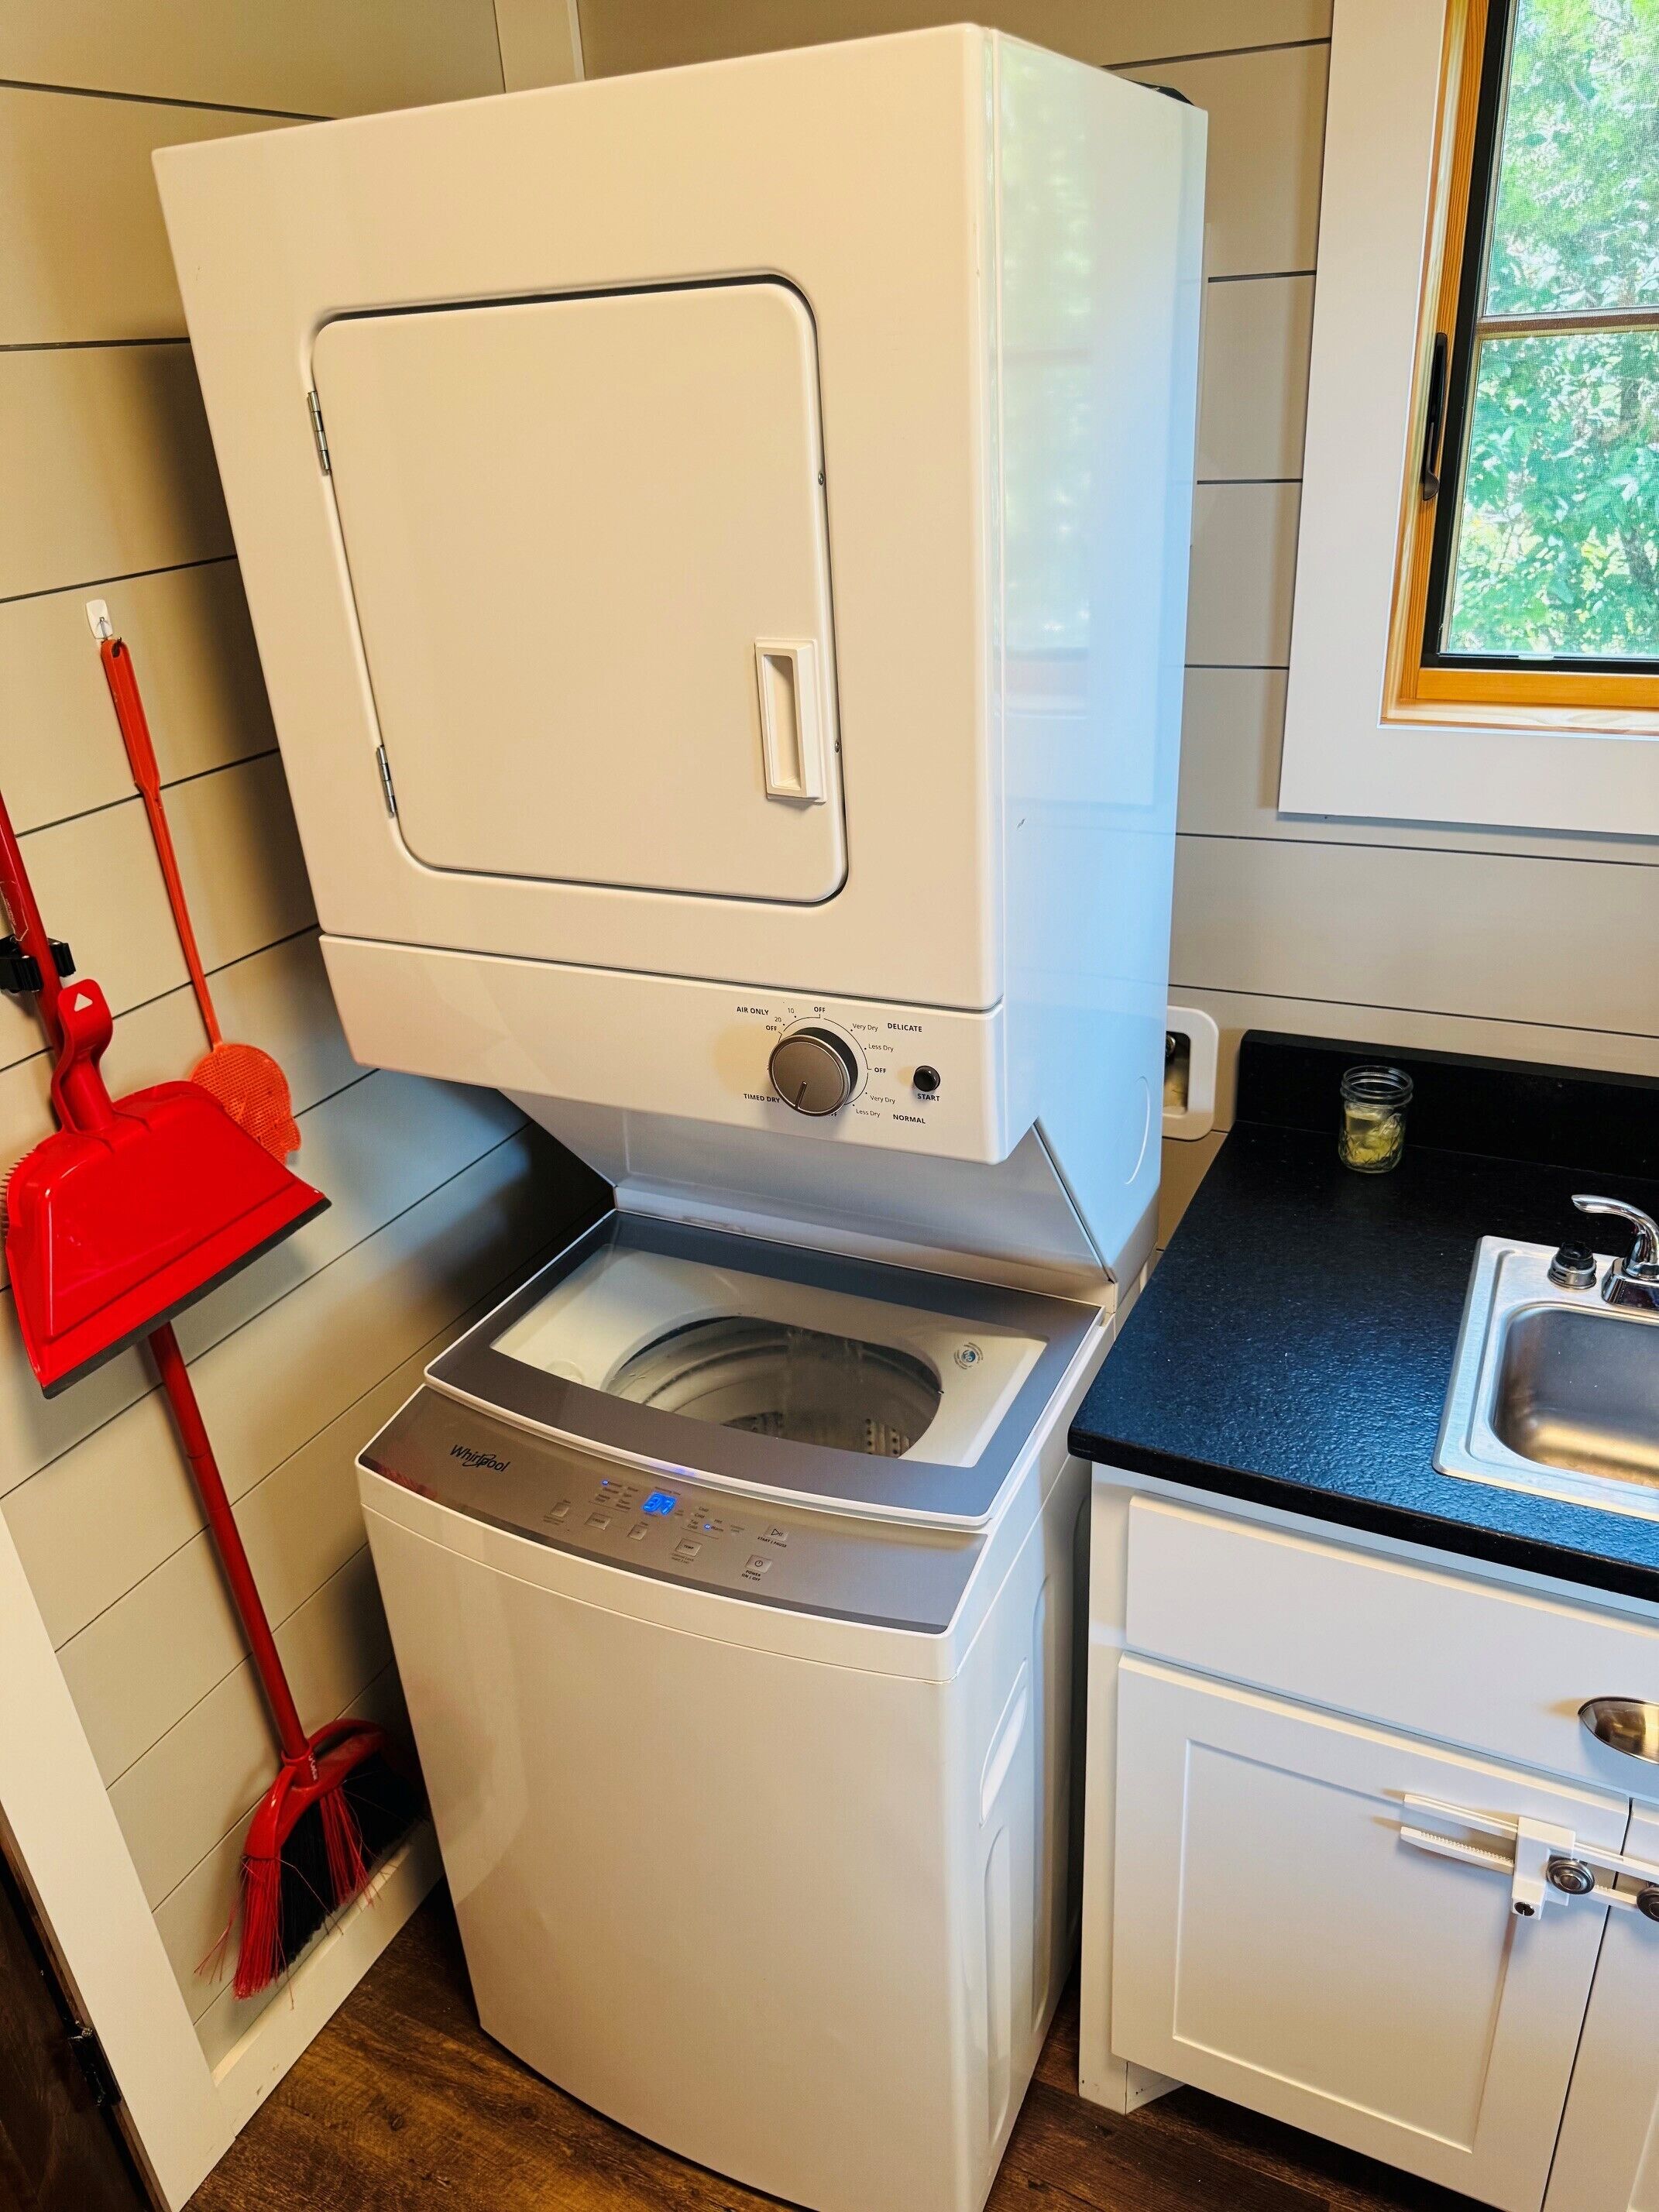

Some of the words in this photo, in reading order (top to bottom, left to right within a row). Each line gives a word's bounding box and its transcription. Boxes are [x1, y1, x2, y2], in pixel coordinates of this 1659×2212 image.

[887, 1022, 922, 1032] DELICATE
[744, 1093, 765, 1101] TIMED
[917, 1093, 940, 1101] START
[893, 1114, 926, 1124] NORMAL
[450, 1444, 510, 1472] Whirlpool
